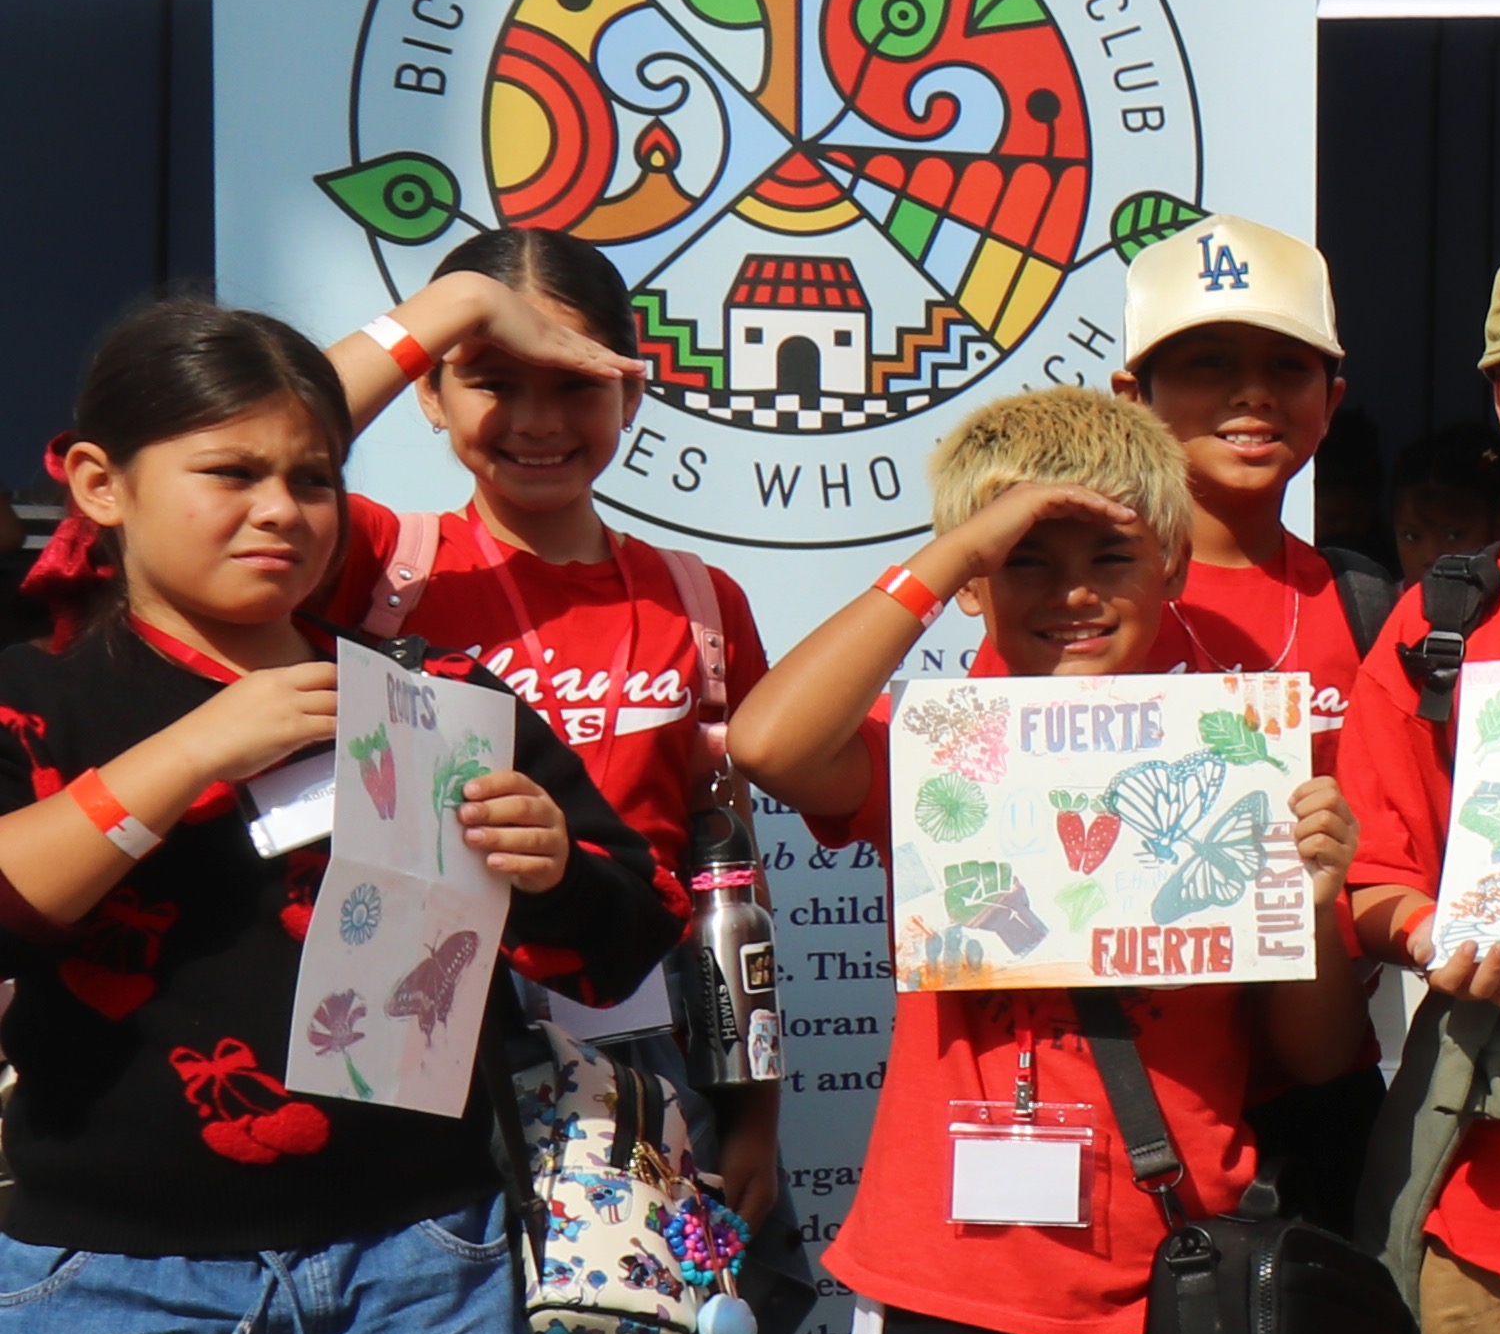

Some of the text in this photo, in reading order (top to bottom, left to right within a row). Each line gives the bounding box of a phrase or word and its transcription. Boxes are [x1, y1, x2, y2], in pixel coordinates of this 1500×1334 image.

[1197, 232, 1249, 291] LA
[754, 455, 901, 509] WHO
[1020, 702, 1164, 754] FUERTE
[808, 840, 841, 870] &
[1091, 927, 1234, 976] FUERTE
